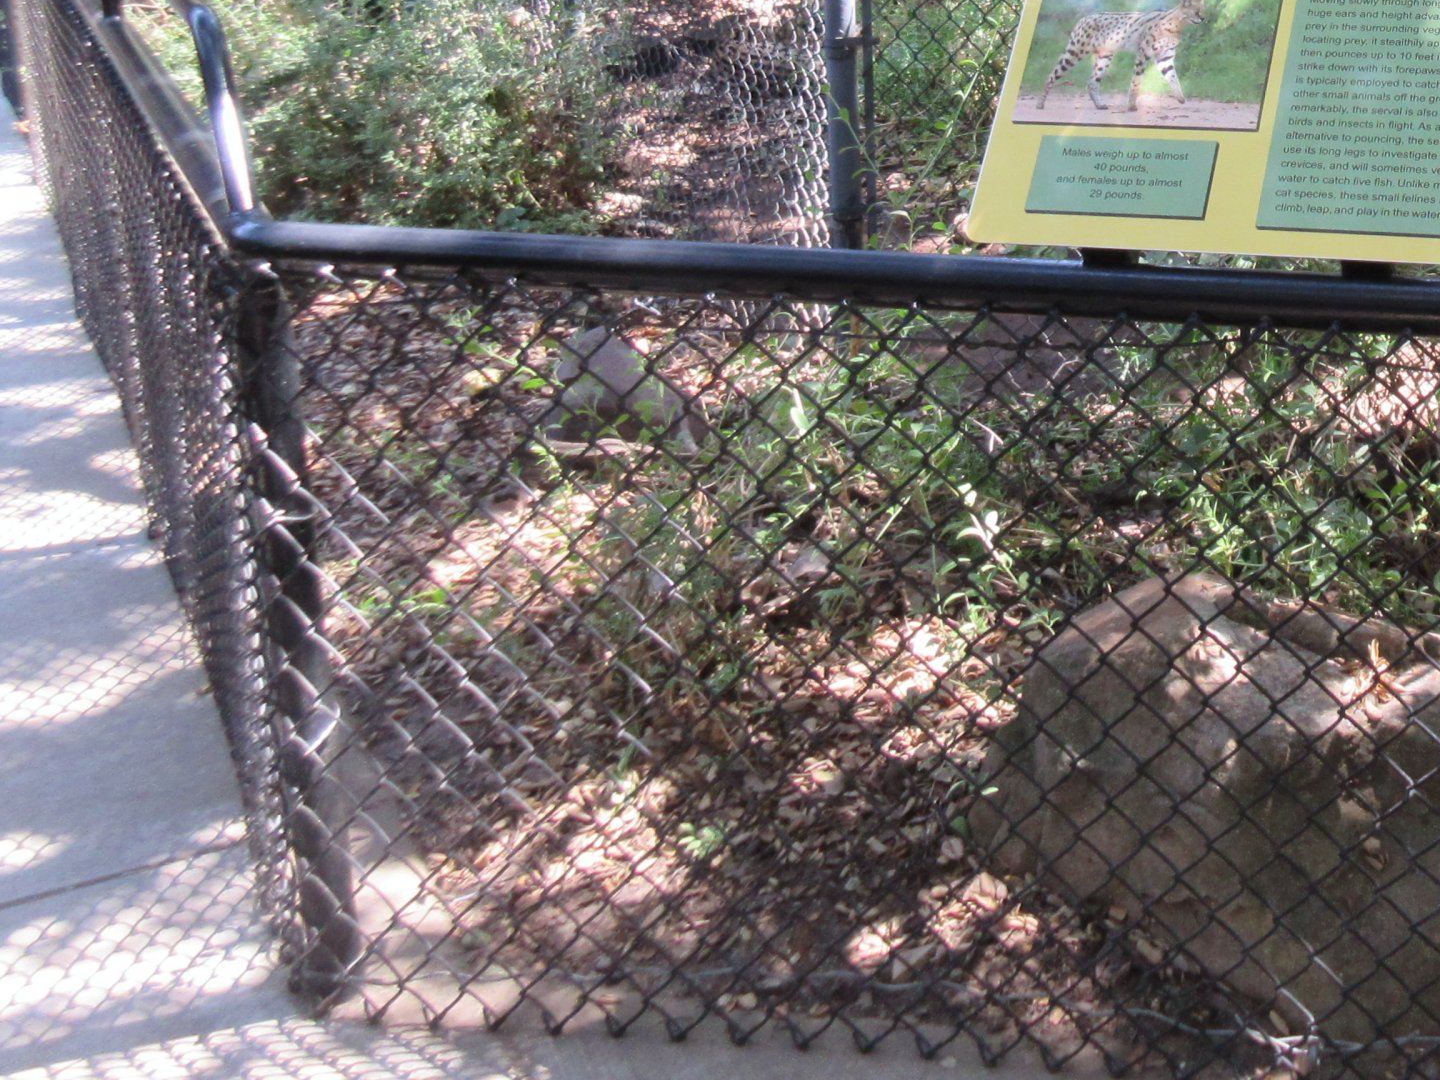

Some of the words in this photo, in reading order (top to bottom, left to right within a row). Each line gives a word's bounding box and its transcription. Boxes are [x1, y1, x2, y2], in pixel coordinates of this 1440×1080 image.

[1307, 7, 1332, 18] huge
[1359, 9, 1379, 18] and
[1380, 10, 1413, 21] height
[1304, 22, 1327, 32] prey
[1328, 21, 1339, 30] in
[1340, 22, 1358, 31] the
[1359, 24, 1420, 35] surrounding
[1302, 34, 1343, 46] locating
[1371, 36, 1378, 45] it
[1379, 37, 1425, 49] stealthily
[1300, 47, 1323, 57] then
[1324, 50, 1369, 59] pounces
[1370, 51, 1384, 61] up
[1385, 50, 1396, 60] to
[1398, 51, 1412, 60] 10
[1414, 51, 1436, 61] feet
[1297, 61, 1325, 70] strike
[1327, 62, 1355, 72] down
[1357, 63, 1379, 72] with
[1306, 75, 1347, 88] typically
[1402, 79, 1413, 88] to
[1292, 88, 1320, 98] other
[1321, 90, 1349, 99] small
[1351, 91, 1391, 101] animals
[1393, 92, 1408, 101] off
[1409, 92, 1427, 102] the
[1352, 104, 1368, 114] the
[1371, 106, 1403, 115] serval
[1405, 106, 1415, 116] is
[1416, 107, 1439, 117] also
[1287, 116, 1313, 126] birds
[1315, 117, 1336, 127] and
[1337, 118, 1374, 128] insects
[1375, 119, 1386, 129] in
[1417, 121, 1432, 131] As
[1285, 130, 1339, 141] alternative
[1341, 132, 1352, 142] to
[1407, 135, 1424, 145] the
[1062, 147, 1092, 157] Males
[1095, 149, 1124, 160] weigh
[1126, 151, 1139, 161] up
[1142, 150, 1152, 159] to
[1155, 151, 1189, 160] almost
[1283, 146, 1302, 154] use
[1304, 145, 1317, 155] its
[1318, 146, 1341, 158] long
[1343, 147, 1366, 159] legs
[1367, 148, 1379, 158] to
[1381, 148, 1438, 162] investigate
[1093, 162, 1107, 171] 40
[1328, 161, 1350, 171] and
[1351, 162, 1369, 171] will
[1370, 163, 1428, 174] sometimes
[1056, 174, 1075, 183] and
[1078, 175, 1117, 185] females
[1120, 178, 1133, 187] up
[1136, 177, 1146, 186] to
[1148, 177, 1183, 187] almost
[1277, 173, 1307, 183] water
[1308, 174, 1320, 184] to
[1321, 175, 1351, 185] catch
[1352, 176, 1371, 186] live
[1397, 178, 1430, 189] Unlike
[1089, 188, 1102, 198] 29
[1274, 187, 1292, 197] cat
[1339, 190, 1369, 201] these
[1371, 192, 1400, 202] small
[1401, 193, 1436, 204] felines
[1333, 205, 1354, 215] and
[1356, 206, 1379, 219] play
[1379, 207, 1391, 217] in
[1392, 207, 1410, 218] the
